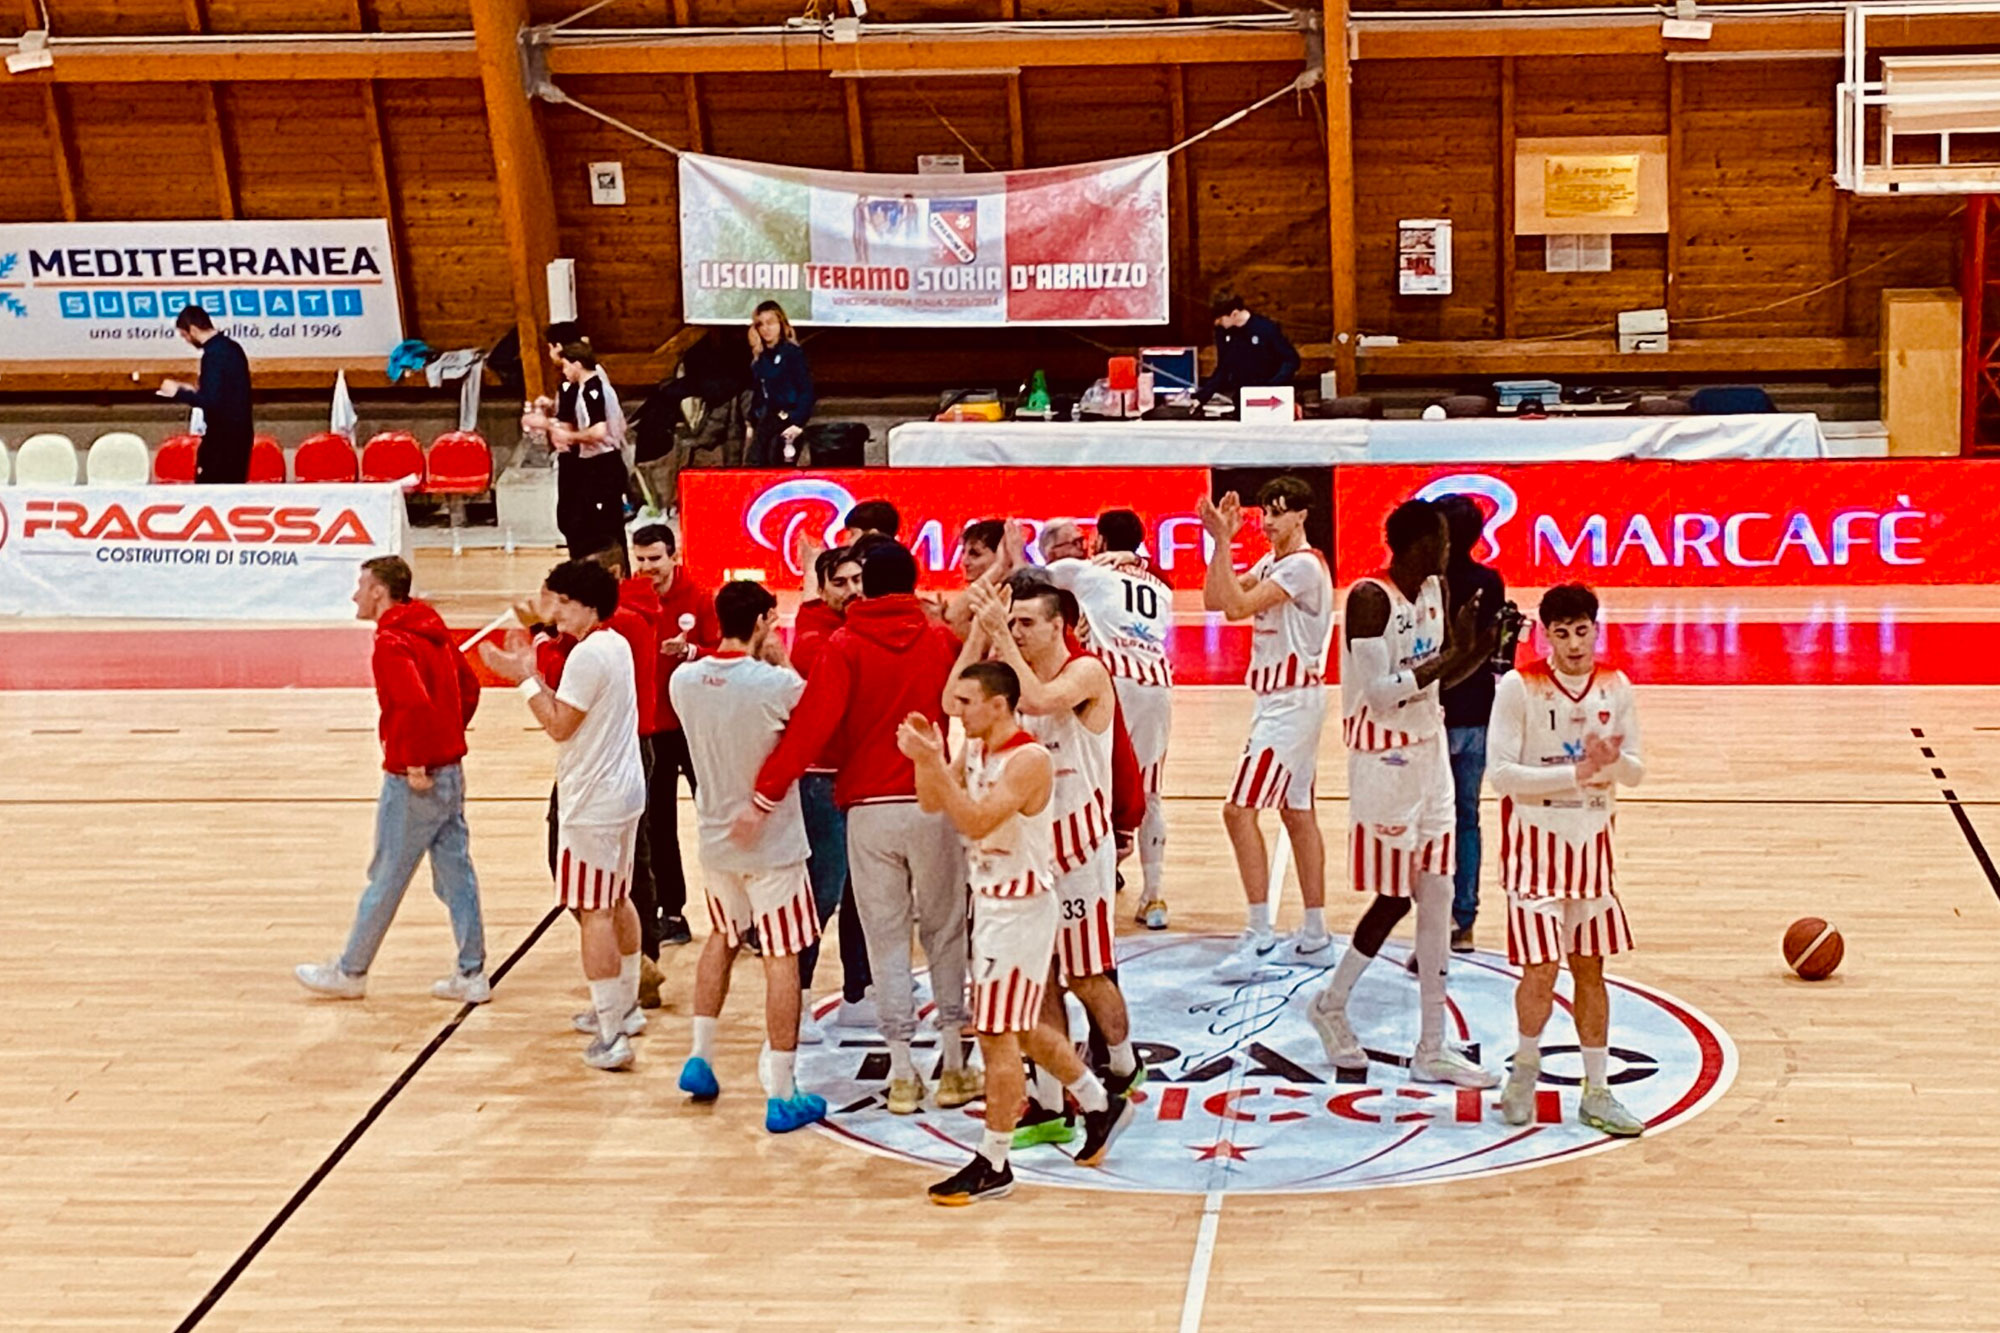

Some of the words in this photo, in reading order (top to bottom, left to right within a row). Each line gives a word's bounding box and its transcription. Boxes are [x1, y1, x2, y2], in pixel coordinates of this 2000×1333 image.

[28, 246, 381, 278] MEDITERRANEA
[700, 262, 799, 290] LISCIANI
[806, 264, 909, 291] TERAMO
[917, 266, 1002, 291] STORIA
[1010, 263, 1148, 290] D'ABRUZZO
[64, 292, 354, 315] SURGELATI
[89, 326, 122, 340] una
[127, 324, 175, 340] storia
[269, 323, 296, 338] dal
[302, 324, 342, 338] 1996
[23, 501, 375, 545] FRACASSA
[1534, 494, 1926, 567] MARCAFÈ
[95, 547, 213, 565] COSTRUTTORI
[216, 549, 234, 565] DI
[238, 549, 299, 567] STORIA
[1120, 578, 1158, 620] 10
[1062, 898, 1086, 920] 33
